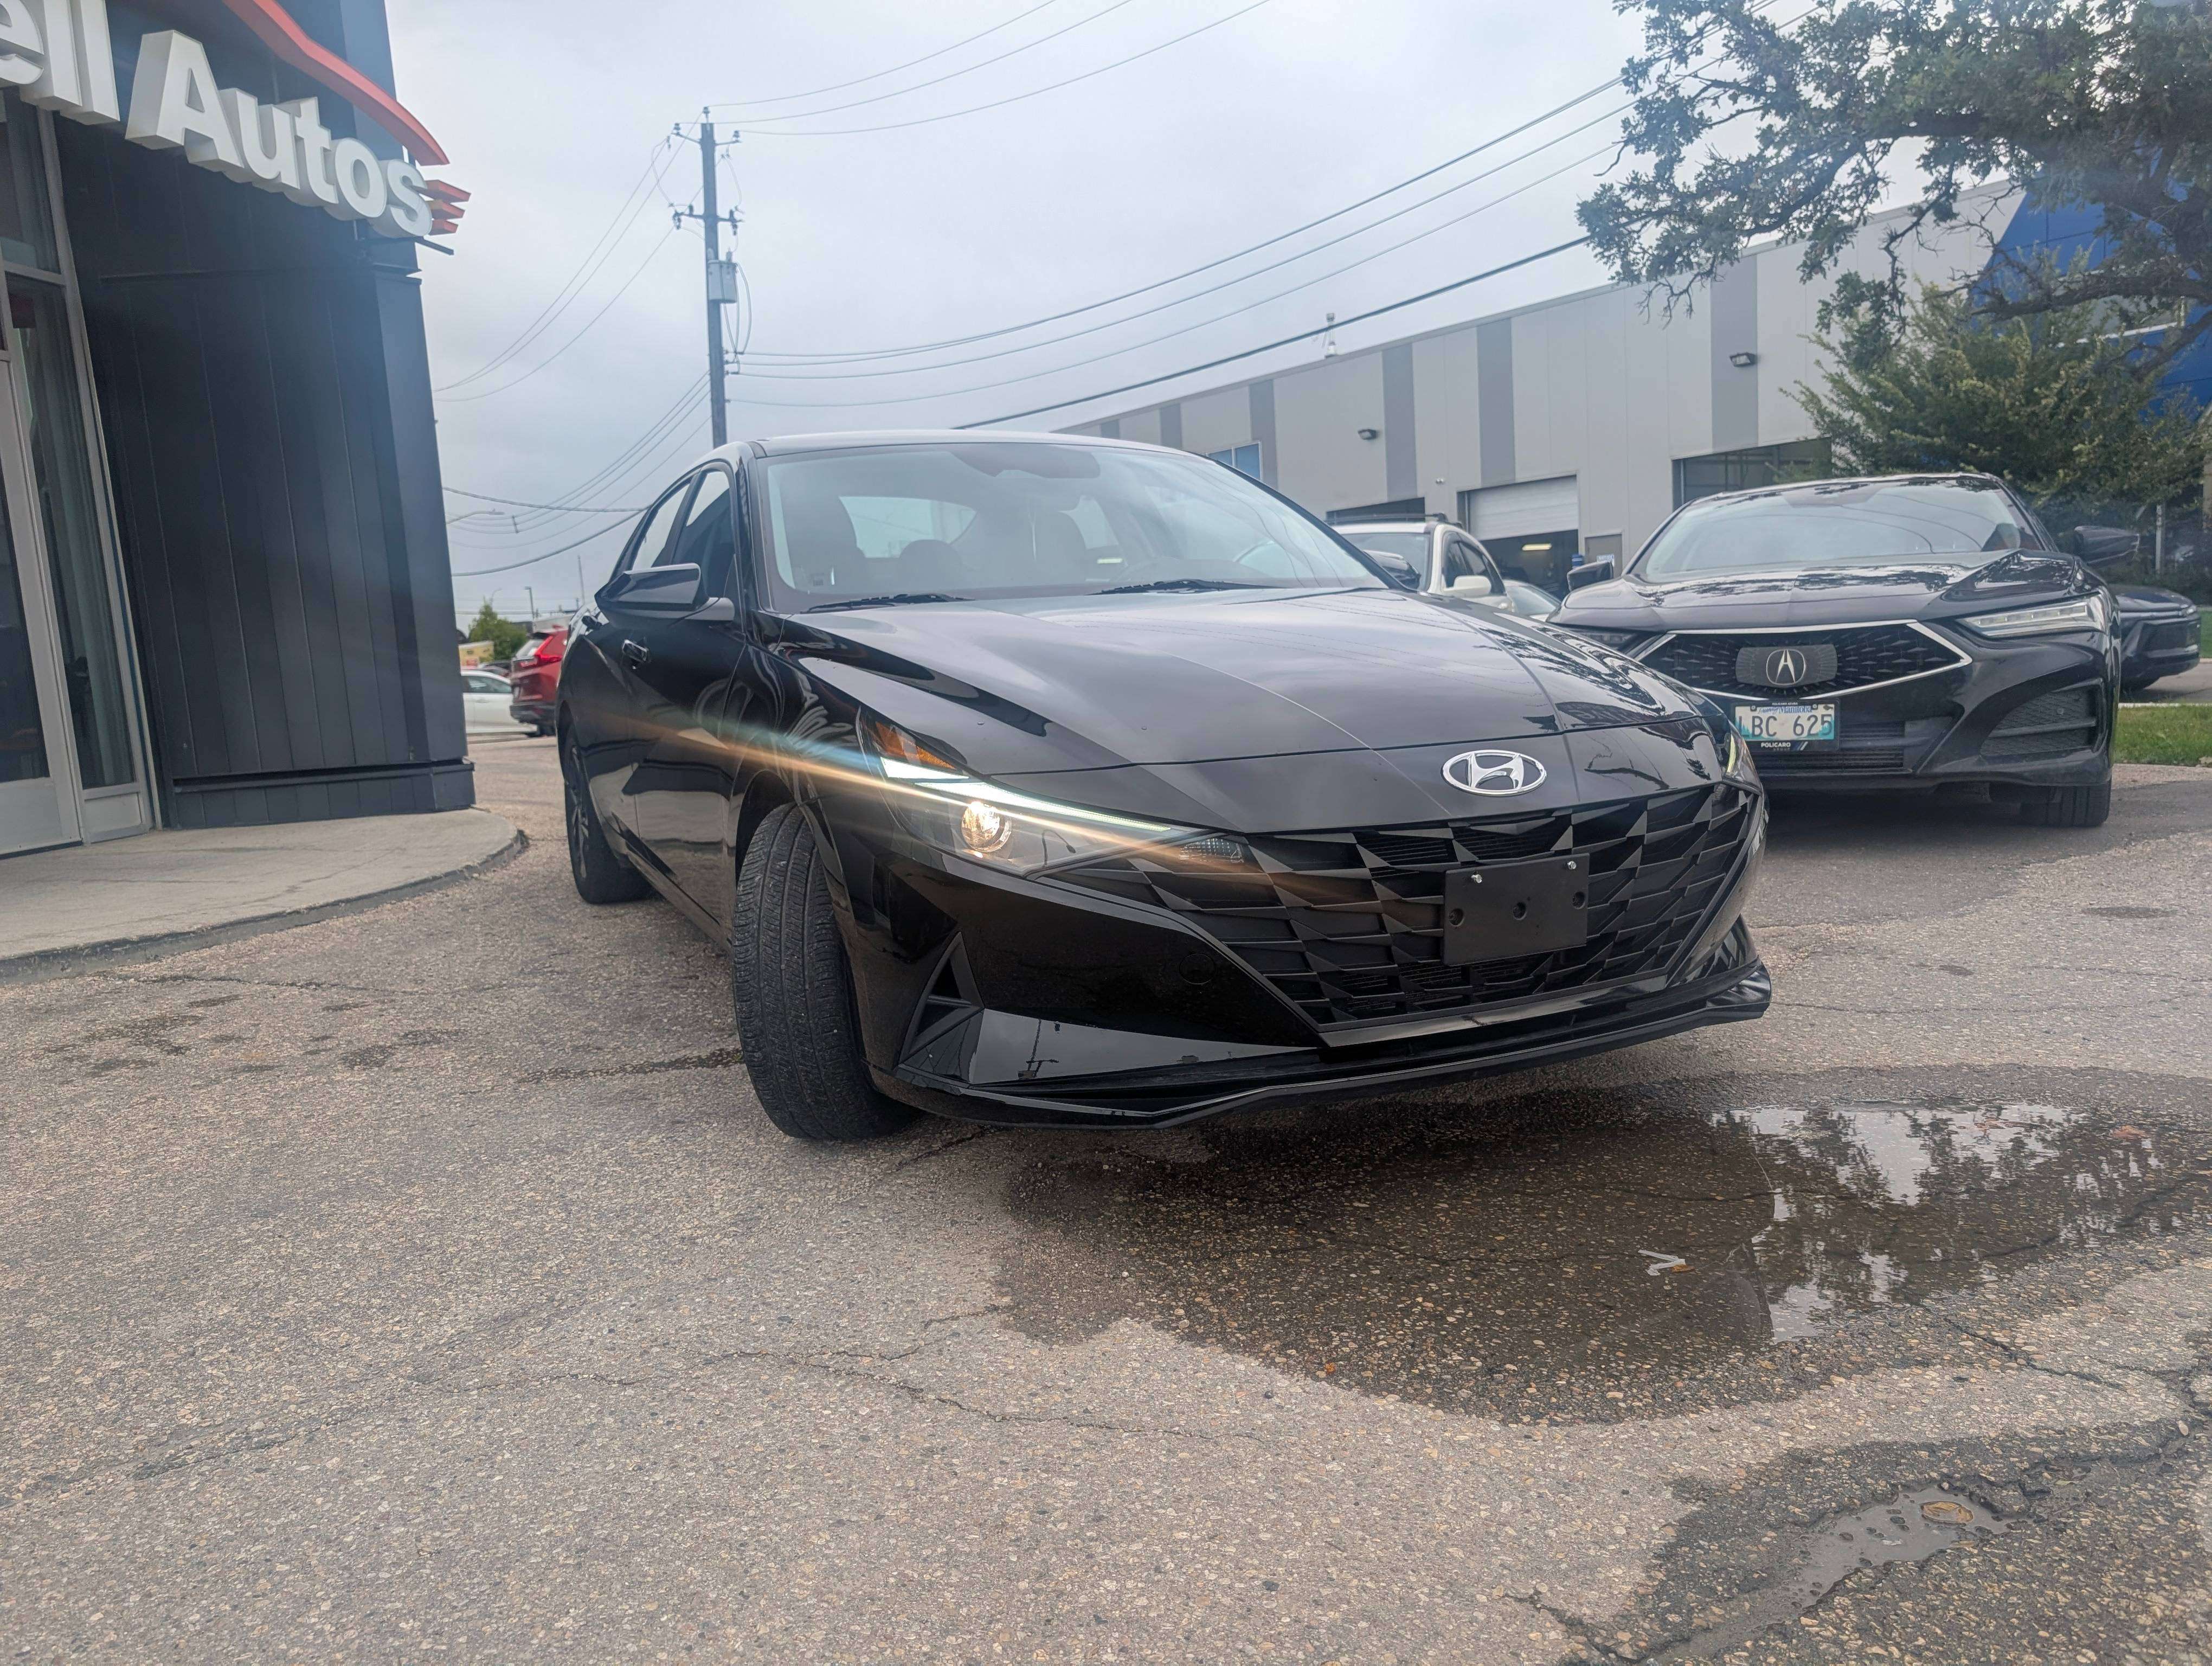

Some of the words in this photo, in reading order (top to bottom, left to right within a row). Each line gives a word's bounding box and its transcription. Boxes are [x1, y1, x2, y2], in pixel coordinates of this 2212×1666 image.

[126, 29, 433, 239] Autos
[1739, 715, 1777, 738] LBC
[1792, 714, 1832, 736] 625
